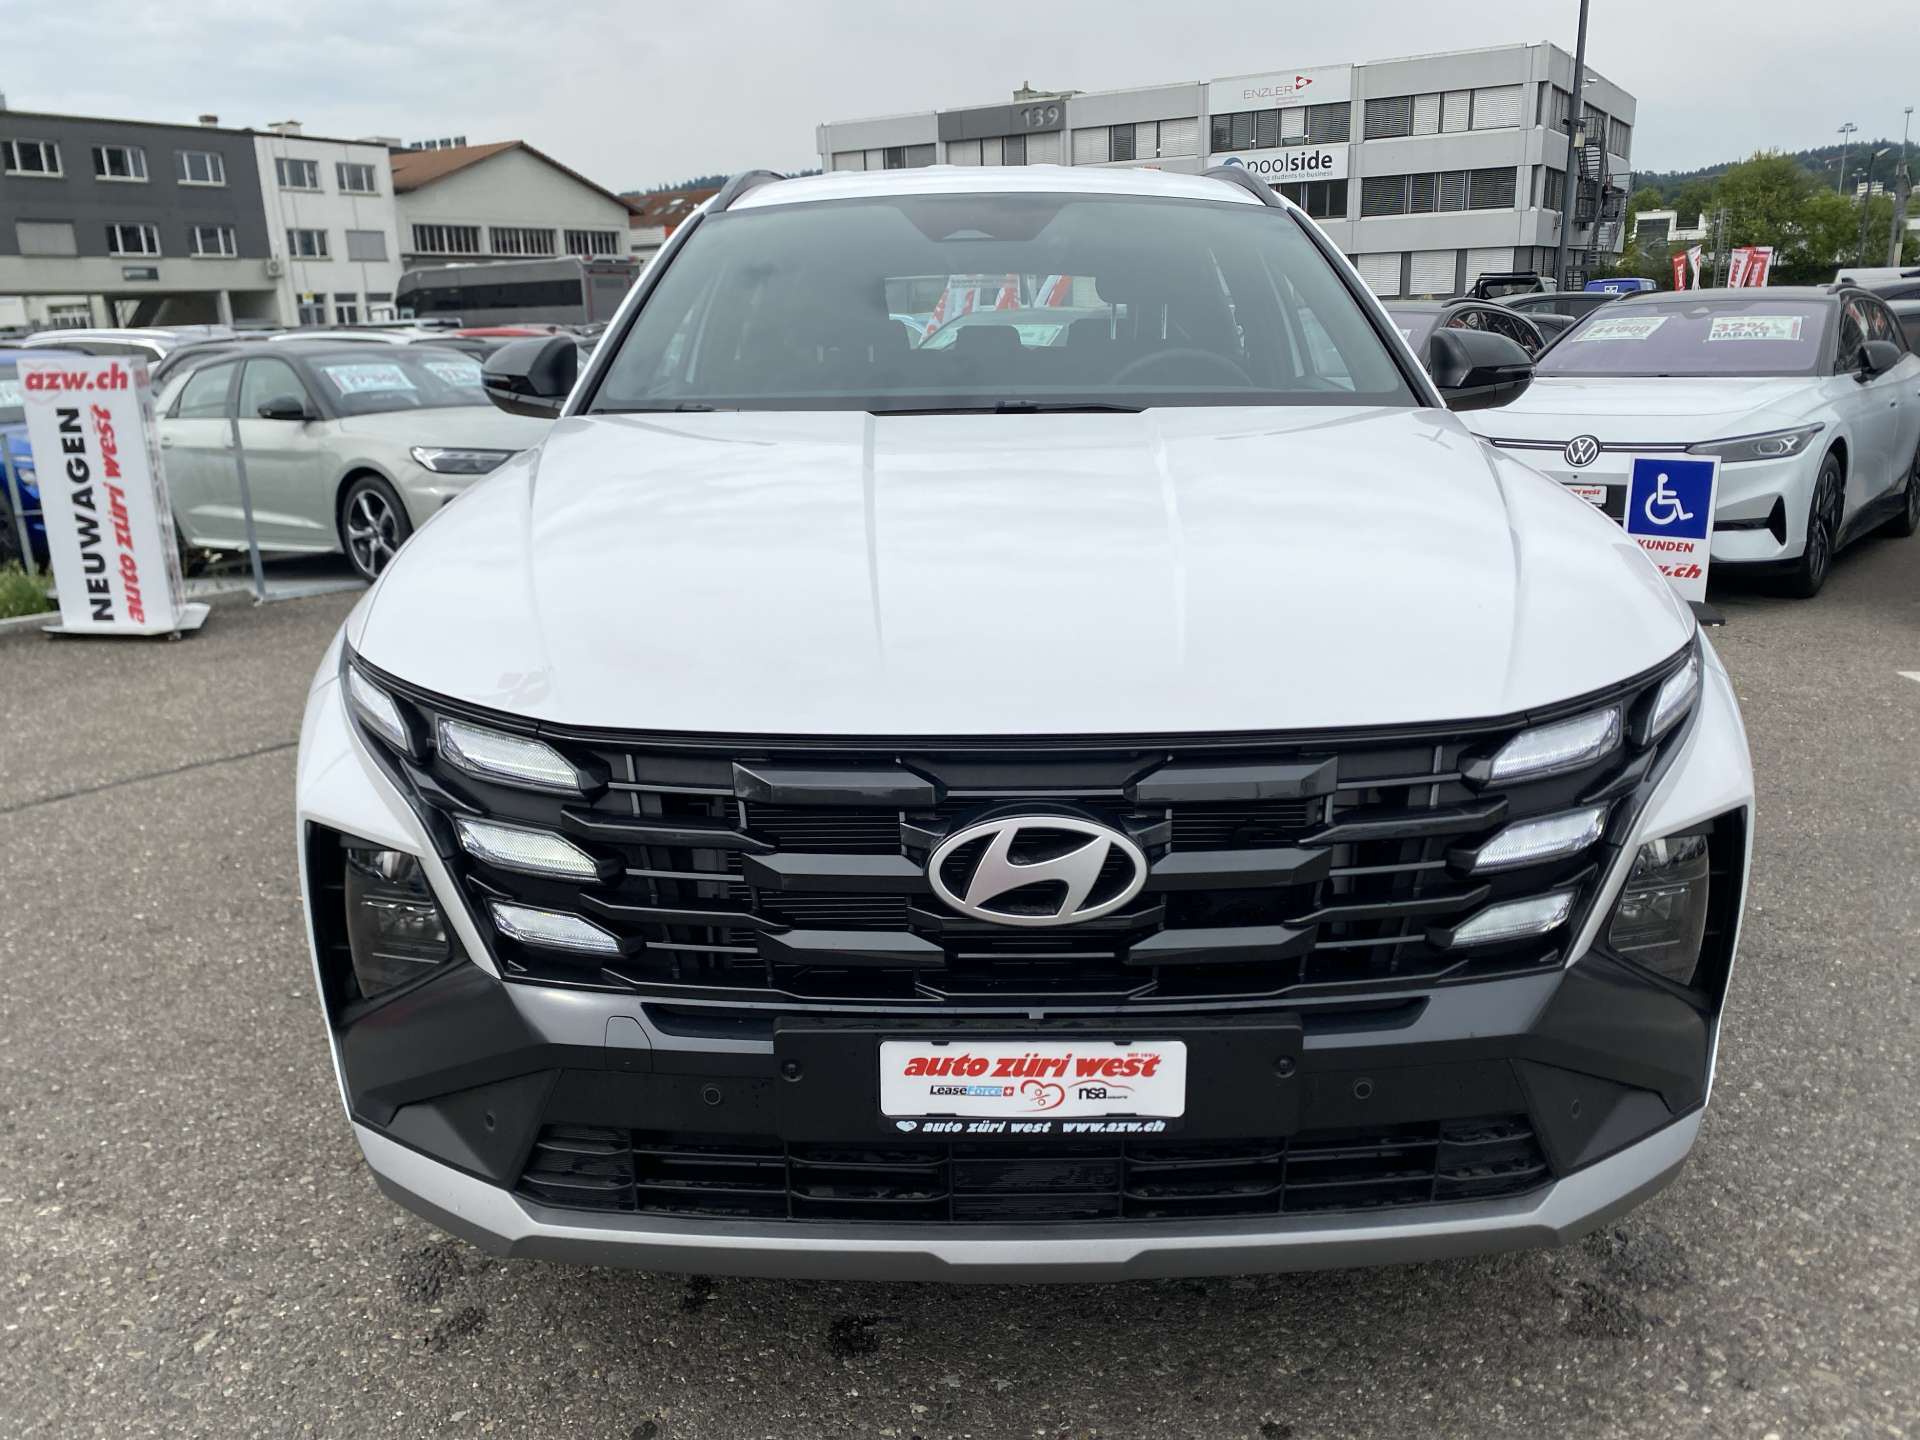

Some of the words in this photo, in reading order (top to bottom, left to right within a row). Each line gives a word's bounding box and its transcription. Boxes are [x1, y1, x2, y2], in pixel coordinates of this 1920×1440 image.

[1243, 85, 1293, 99] ENZLER
[1020, 106, 1059, 127] 139
[1247, 150, 1332, 174] poolside
[25, 362, 128, 390] azw.ch
[89, 403, 122, 479] west
[56, 407, 115, 622] NEUWAGEN
[103, 481, 134, 551] züri
[1637, 539, 1694, 552] KUNDEN
[120, 552, 145, 625] auto
[904, 1053, 989, 1077] auto
[990, 1053, 1072, 1077] züri
[1076, 1055, 1162, 1077] west
[930, 1085, 1002, 1097] LeaseForce
[1079, 1087, 1107, 1100] nsa
[922, 1121, 963, 1133] auto
[966, 1120, 1006, 1133] züri
[1010, 1121, 1052, 1133] west
[1062, 1120, 1166, 1133] www.azw.ch
